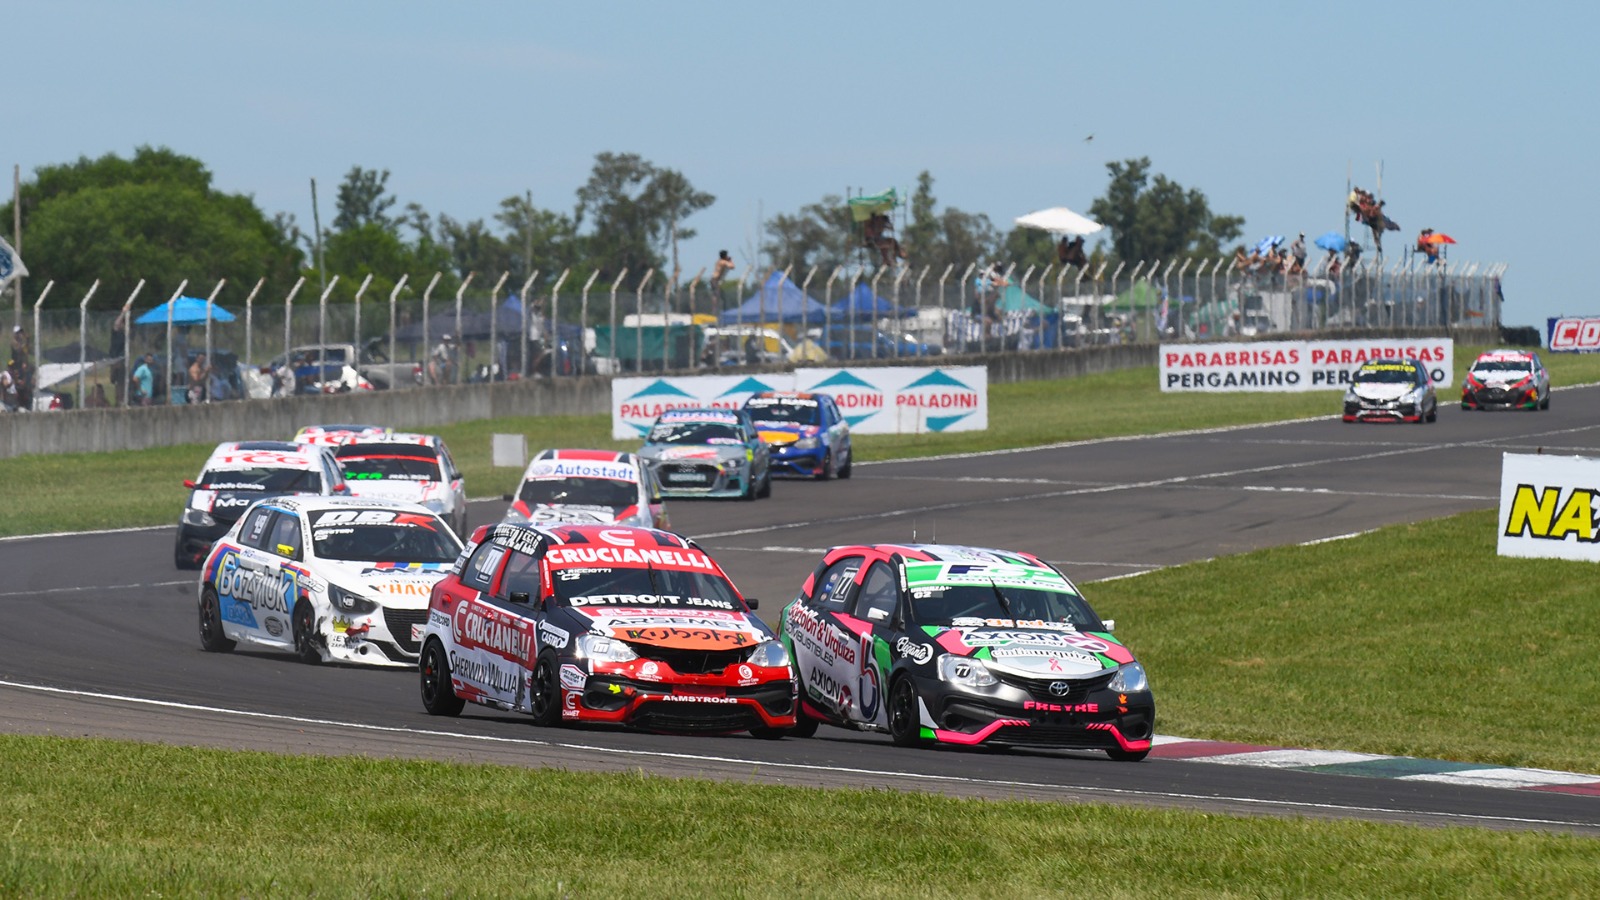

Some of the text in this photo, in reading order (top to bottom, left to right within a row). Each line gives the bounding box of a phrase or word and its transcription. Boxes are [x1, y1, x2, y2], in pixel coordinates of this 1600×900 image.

[1166, 350, 1300, 367] PARABRISAS
[1167, 370, 1300, 388] PERGAMINO
[836, 394, 884, 408] ADINI
[898, 394, 978, 408] PALADINI
[554, 464, 634, 481] Autostadt
[546, 547, 714, 570] CRUCIANELLI
[569, 594, 733, 610] DETROIT JEANS
[608, 617, 746, 630] ARSEMET
[465, 612, 532, 661] CRUCIANELLI
[816, 621, 825, 643] &
[824, 626, 856, 665] Urquiza
[963, 632, 1060, 642] AXION
[955, 665, 970, 676] 77
[810, 666, 840, 700] AXION
[662, 694, 738, 704] ARMSTRONG
[1023, 700, 1099, 713] FREYRE
